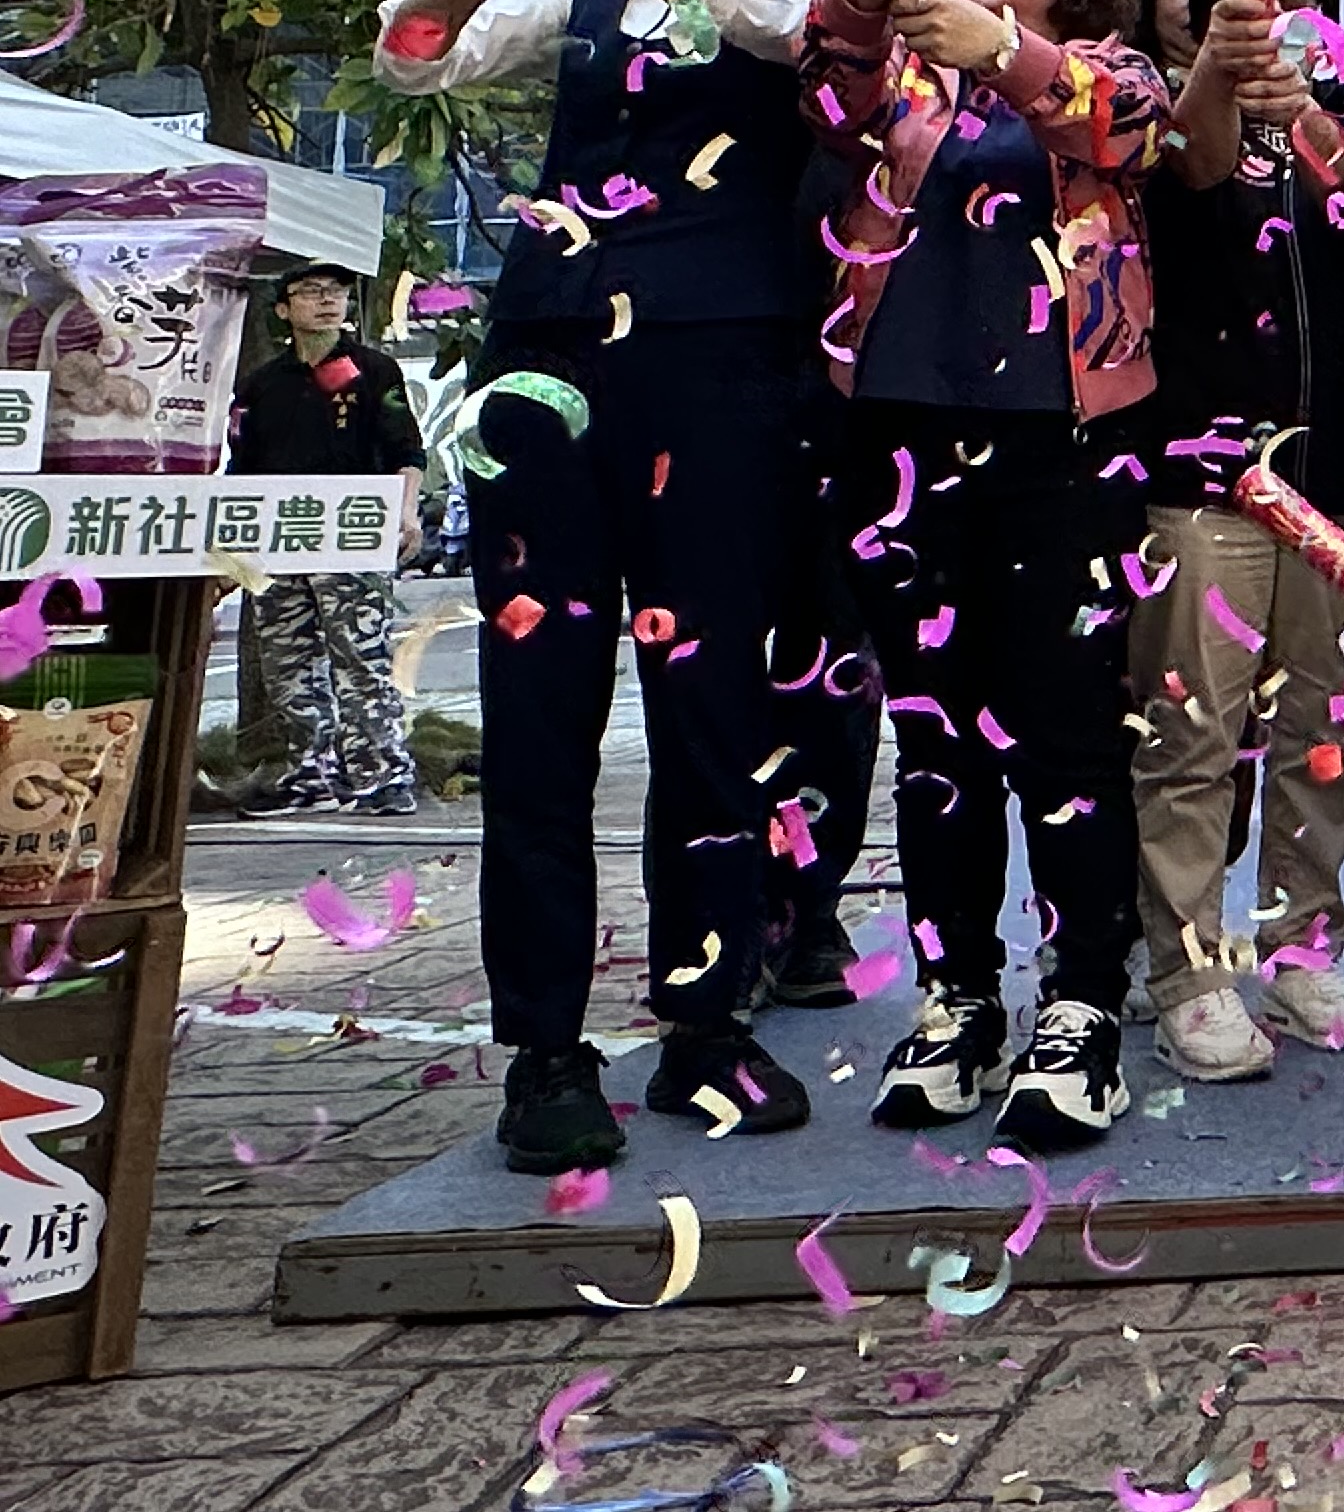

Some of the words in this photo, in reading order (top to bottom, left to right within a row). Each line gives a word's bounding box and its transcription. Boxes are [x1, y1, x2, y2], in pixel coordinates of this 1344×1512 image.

[65, 494, 389, 556] 新社區農會
